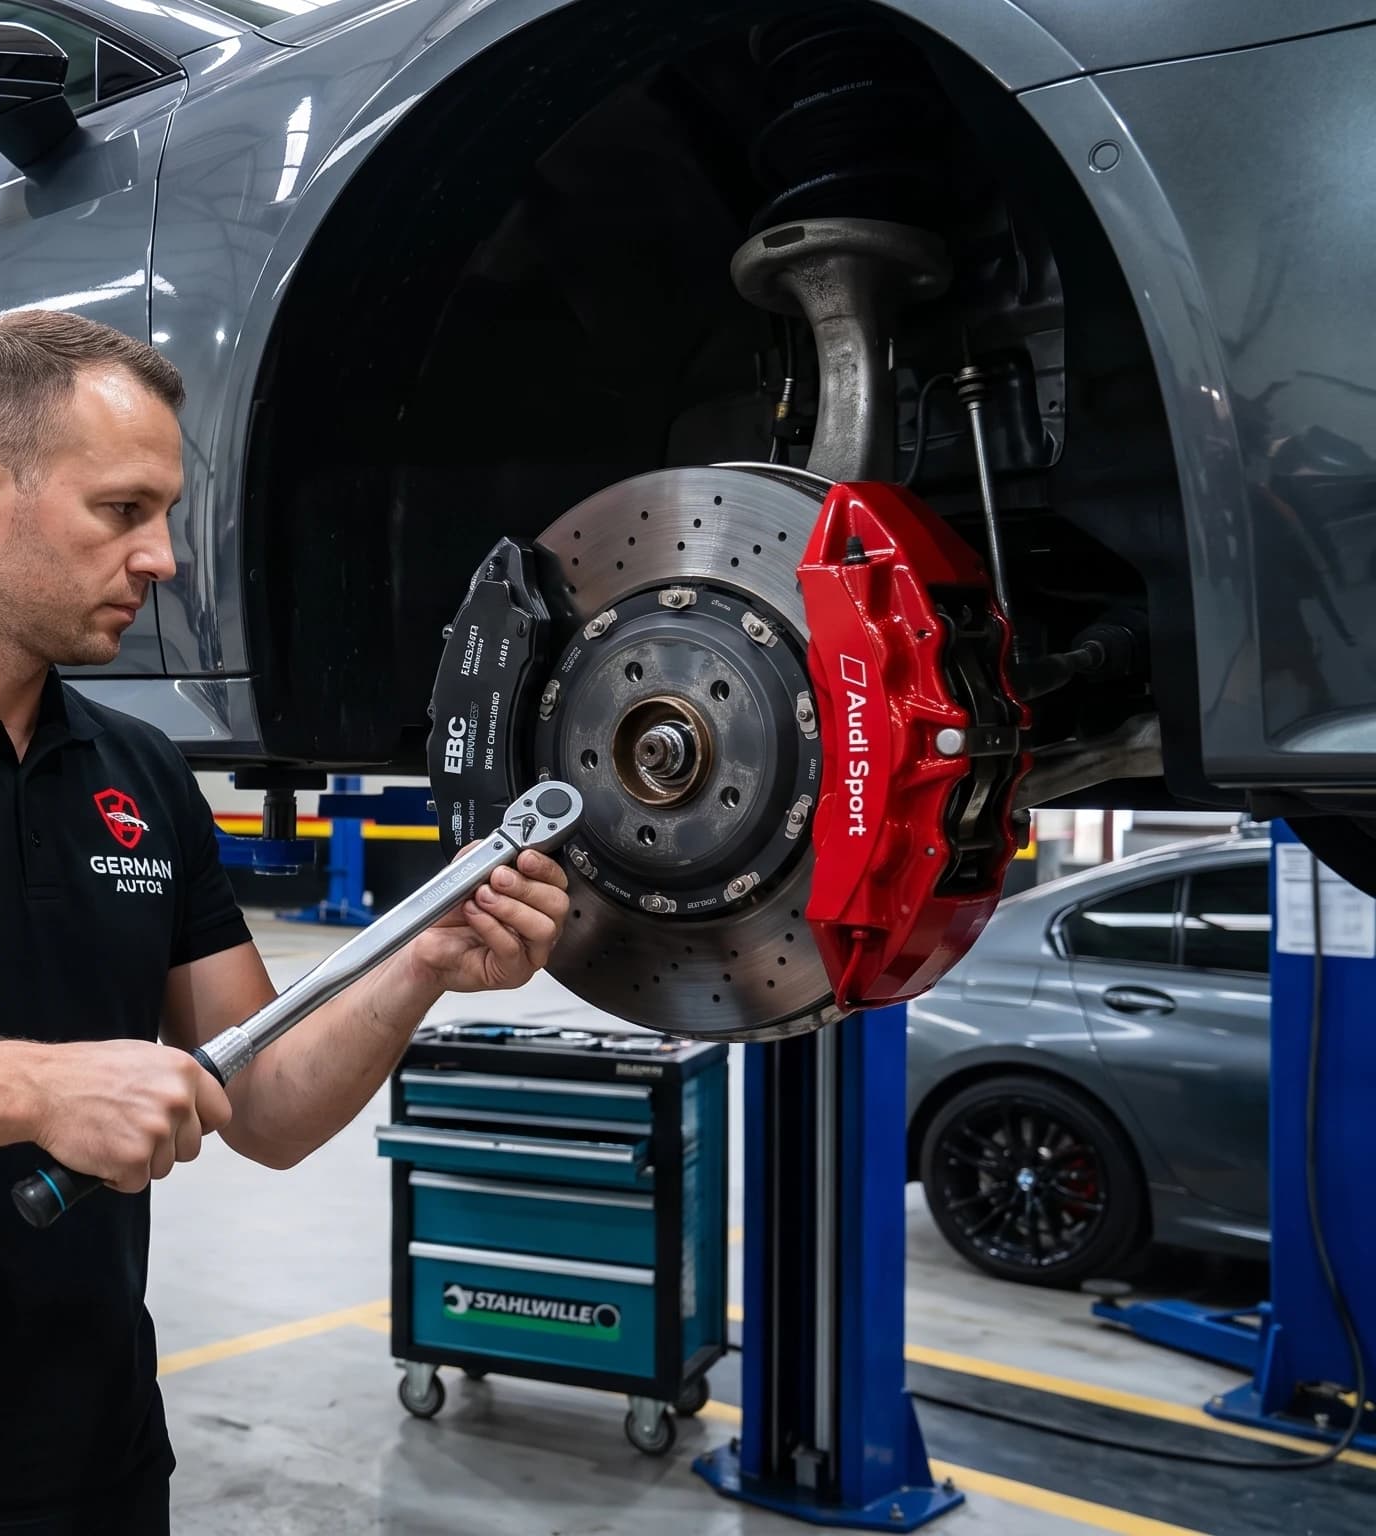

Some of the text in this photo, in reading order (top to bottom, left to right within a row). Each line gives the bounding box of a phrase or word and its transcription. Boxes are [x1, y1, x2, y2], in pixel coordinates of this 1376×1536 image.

[444, 716, 467, 774] EBC
[844, 690, 870, 836] Audi Sport
[90, 856, 172, 880] GERMAN
[474, 1291, 594, 1324] STAHLWILLE
